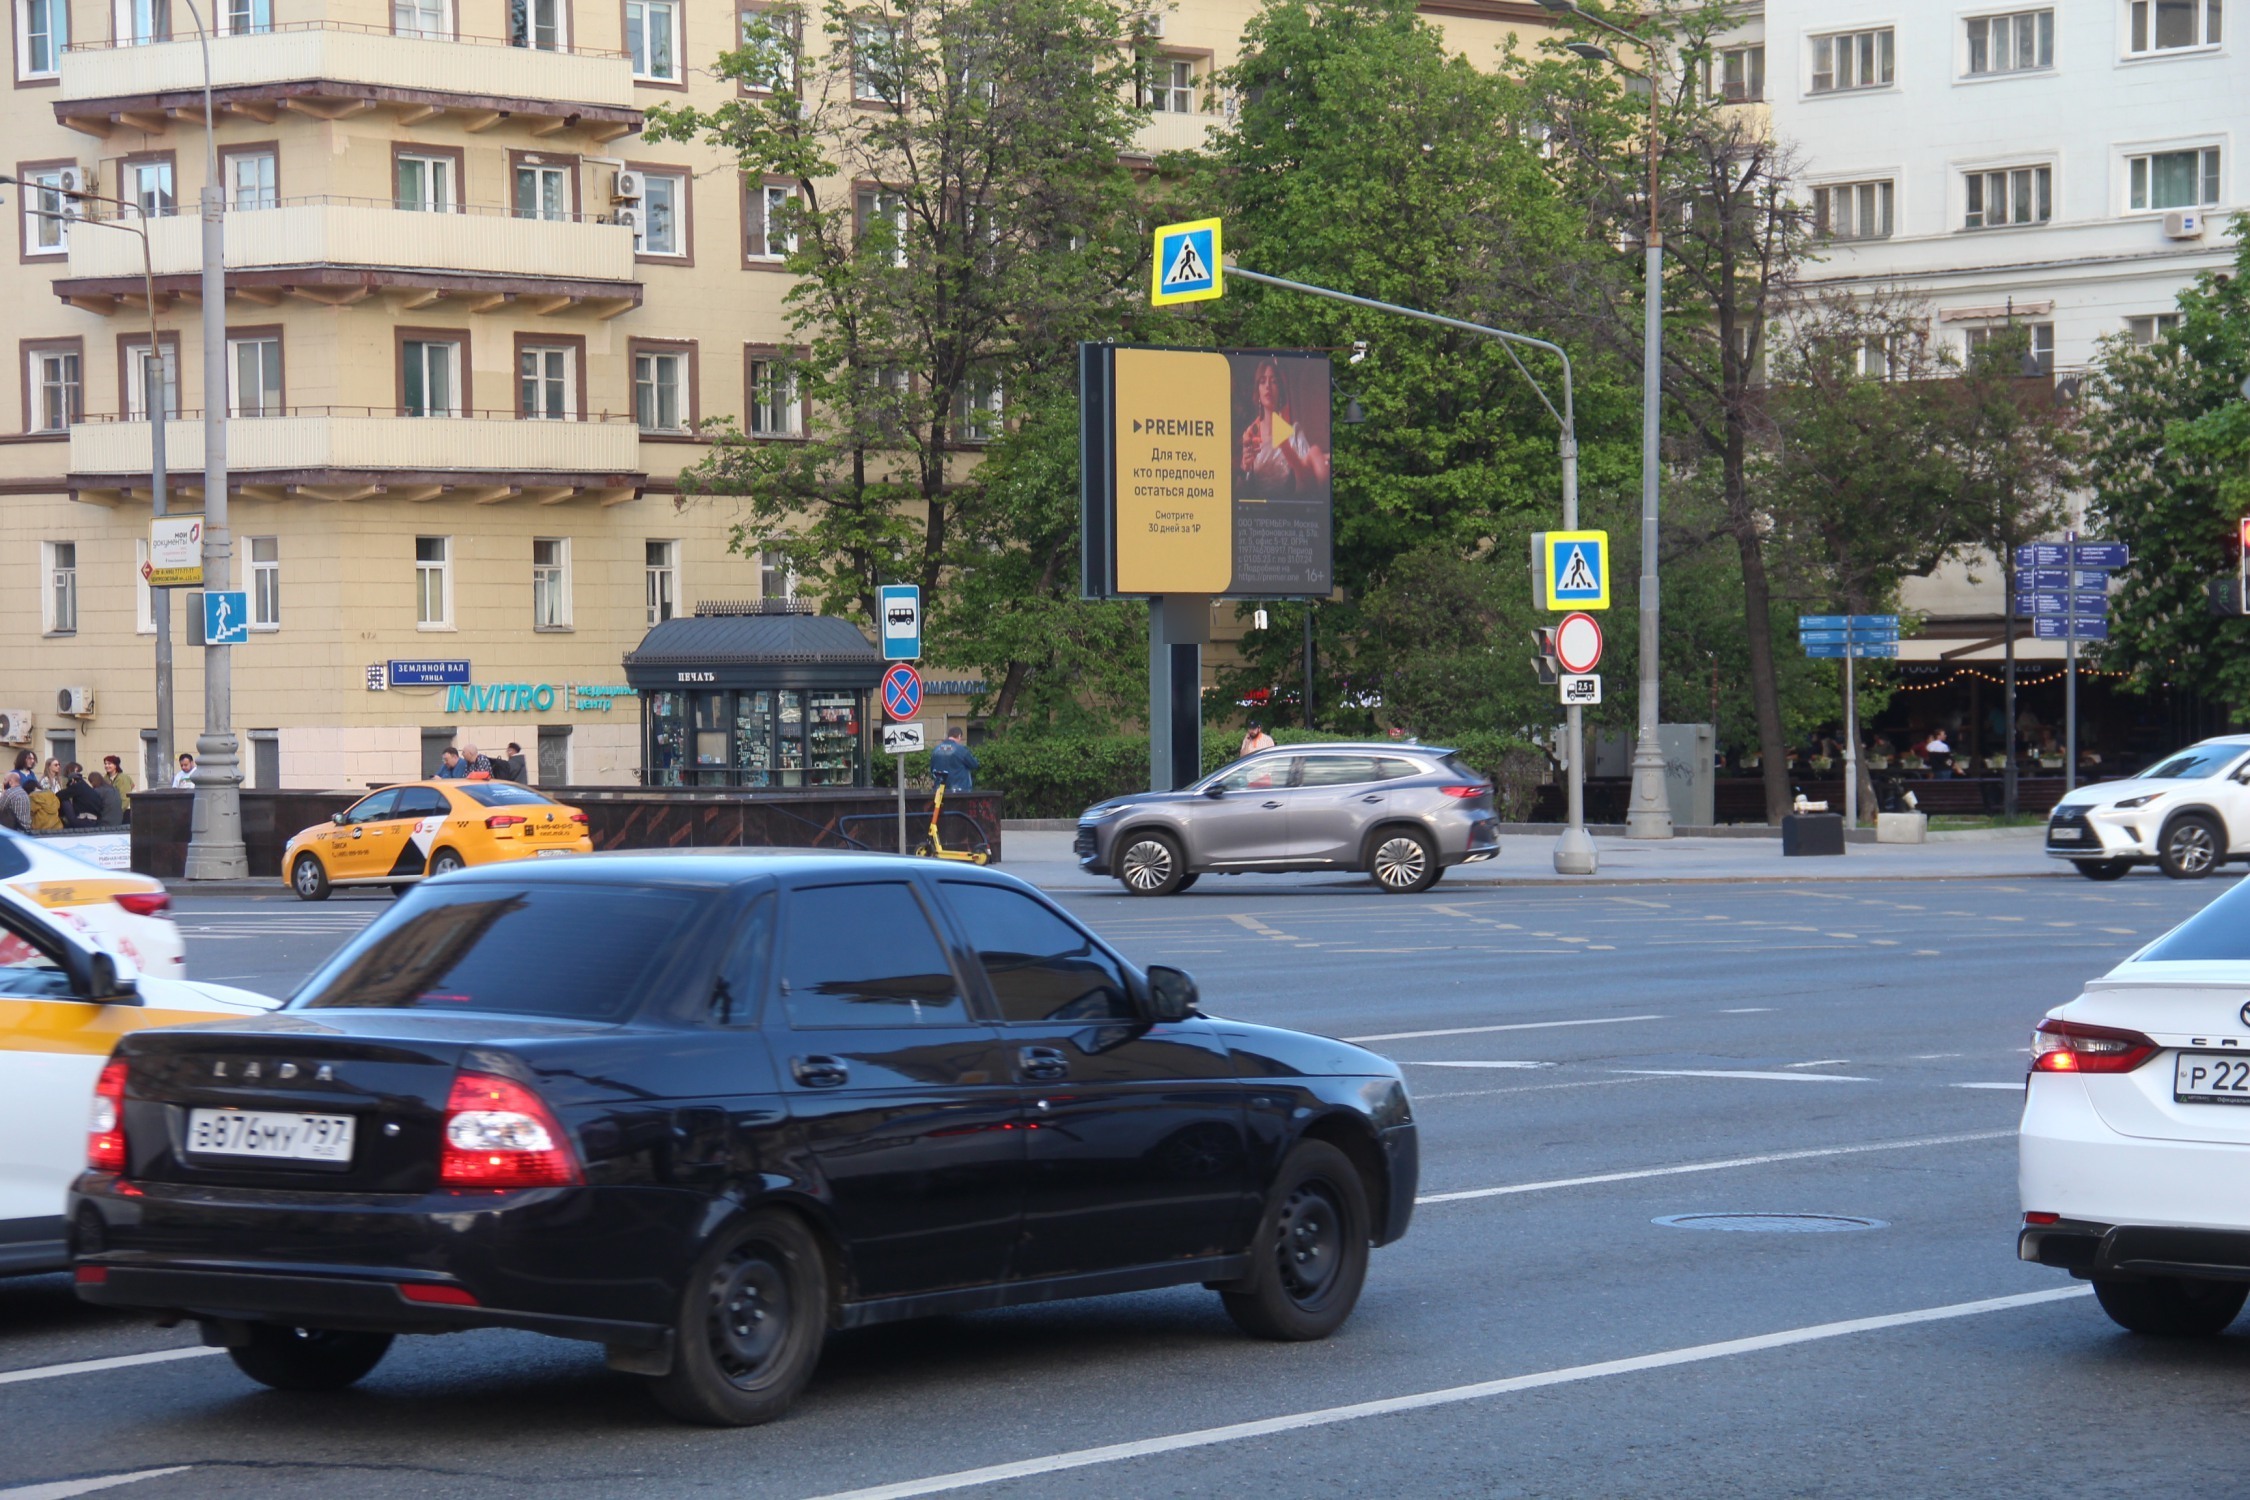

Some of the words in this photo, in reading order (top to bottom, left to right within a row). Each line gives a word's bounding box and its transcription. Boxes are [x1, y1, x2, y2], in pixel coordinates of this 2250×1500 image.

[1145, 418, 1214, 437] PREMIER
[1151, 447, 1173, 462] Для
[1175, 450, 1197, 462] тех,
[1133, 468, 1153, 478] кто
[1155, 468, 1215, 481] предпочел
[1134, 485, 1184, 497] остаться
[1186, 486, 1214, 498] дома
[1155, 510, 1194, 521] Смотрите
[1148, 523, 1159, 533] 30
[1160, 523, 1180, 533] дней
[1181, 525, 1190, 533] за
[1237, 518, 1253, 527] ООО
[152, 539, 188, 550] документы
[1304, 568, 1325, 583] 16+
[398, 662, 446, 673] ЗЕМЛЯНОЙ
[447, 663, 464, 672] ВАЛ
[420, 674, 444, 682] УЛИЦА
[677, 672, 715, 682] ПЕЧАТЬ
[1578, 682, 1588, 691] 2,5
[444, 682, 555, 713] INVITRO
[575, 698, 613, 712] центр
[213, 1061, 333, 1081] LADA
